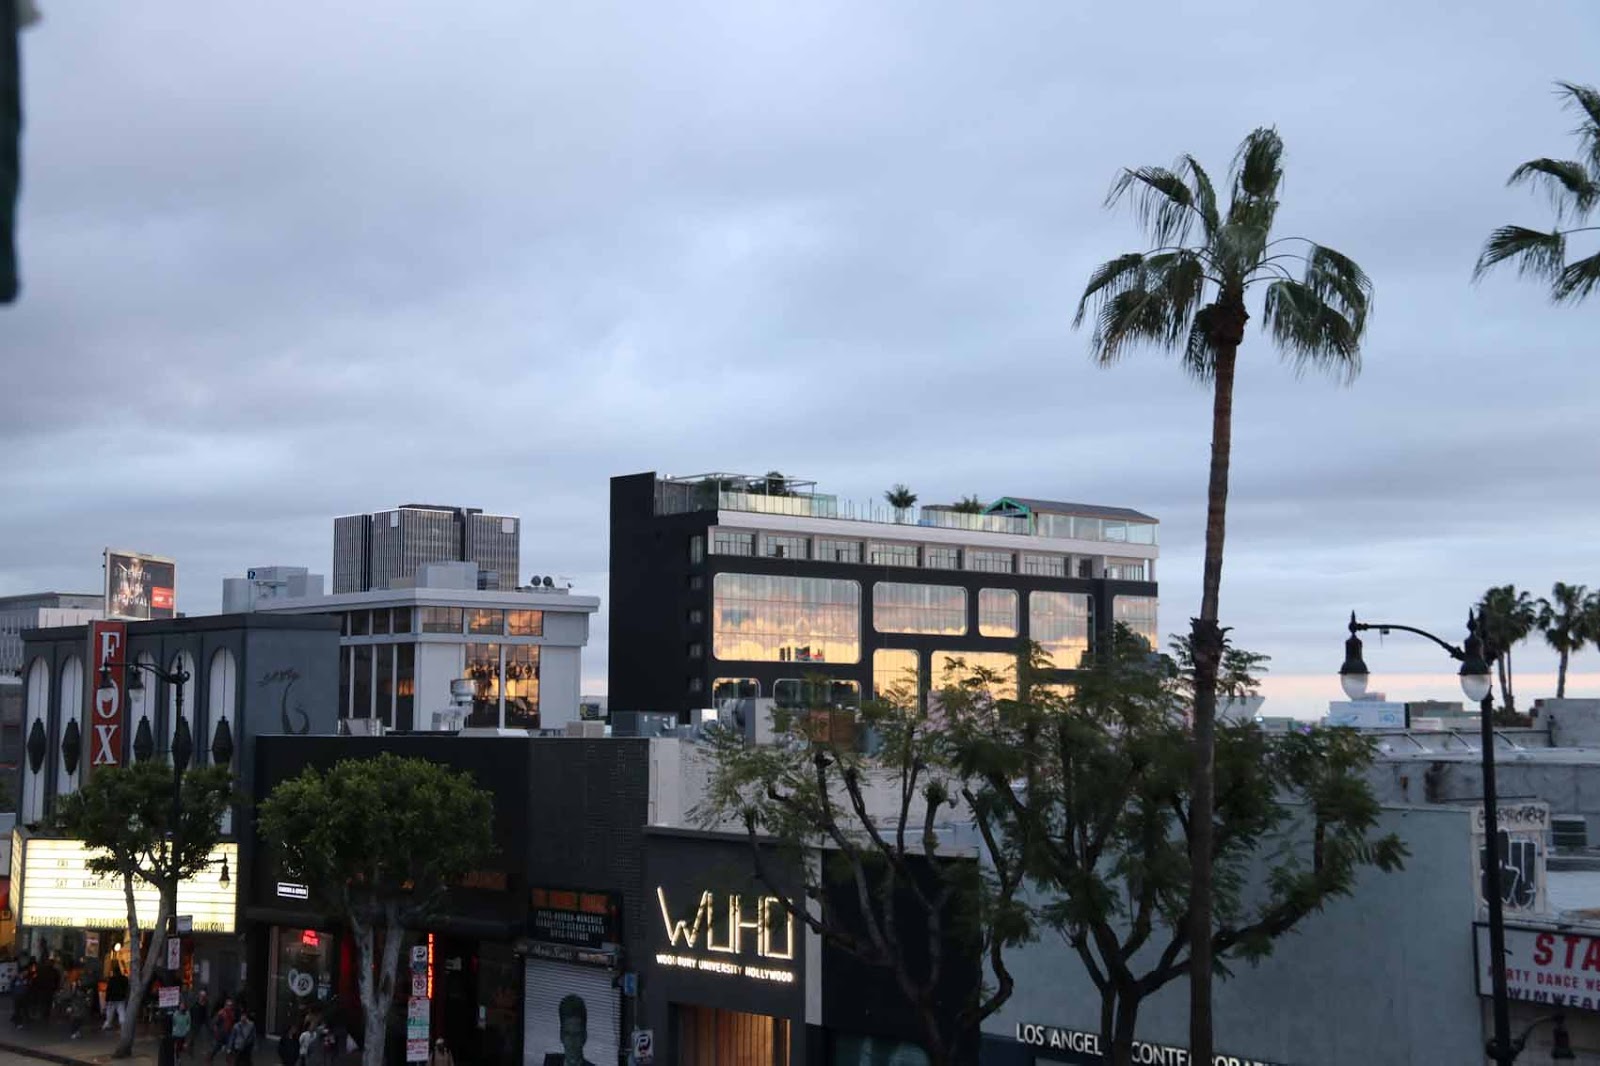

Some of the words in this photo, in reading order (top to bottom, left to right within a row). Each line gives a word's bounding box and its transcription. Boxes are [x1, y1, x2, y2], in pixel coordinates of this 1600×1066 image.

[93, 632, 121, 766] FOX
[1534, 932, 1600, 973] STA
[656, 954, 698, 970] WOODBURY
[699, 959, 743, 977] UNIVERSITY
[744, 966, 794, 984] HOLLYWOOD
[1536, 971, 1580, 988] DANCE
[1016, 1022, 1044, 1046] LOS
